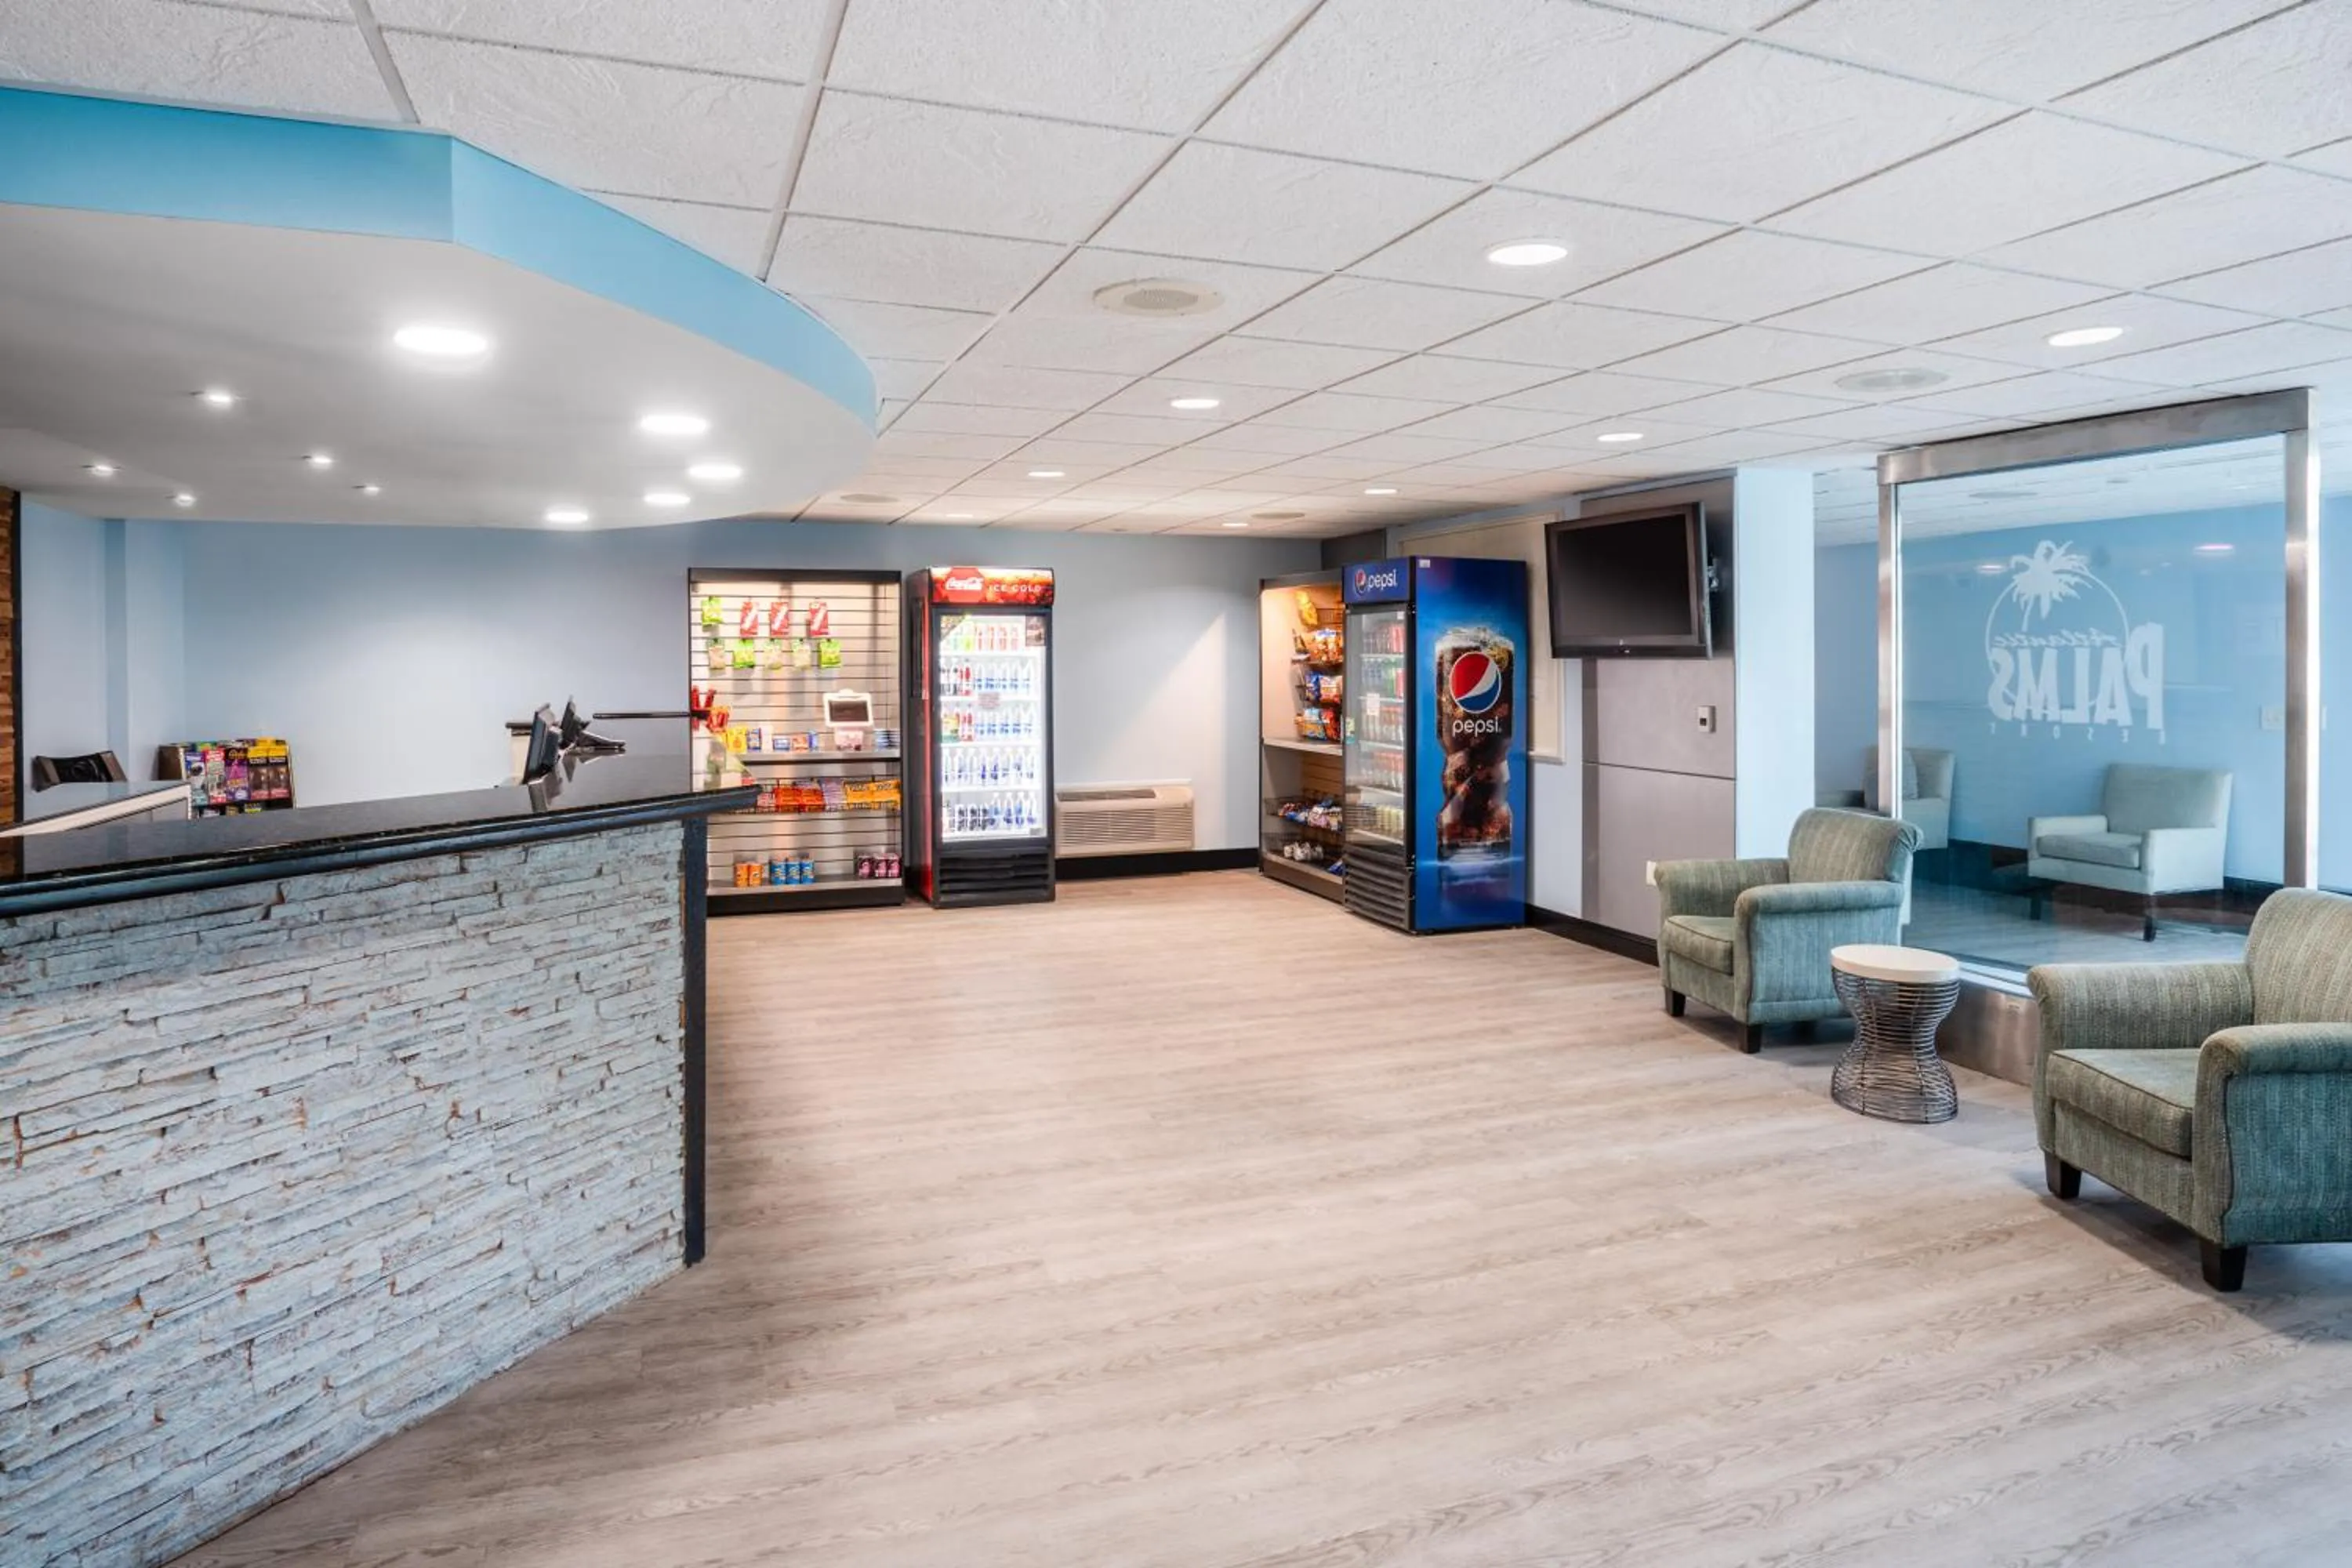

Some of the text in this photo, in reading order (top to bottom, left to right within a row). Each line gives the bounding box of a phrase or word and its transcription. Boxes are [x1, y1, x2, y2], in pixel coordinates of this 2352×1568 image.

[1011, 583, 1042, 593] COLD
[1367, 568, 1398, 593] pepsi
[1451, 715, 1499, 738] pepsi
